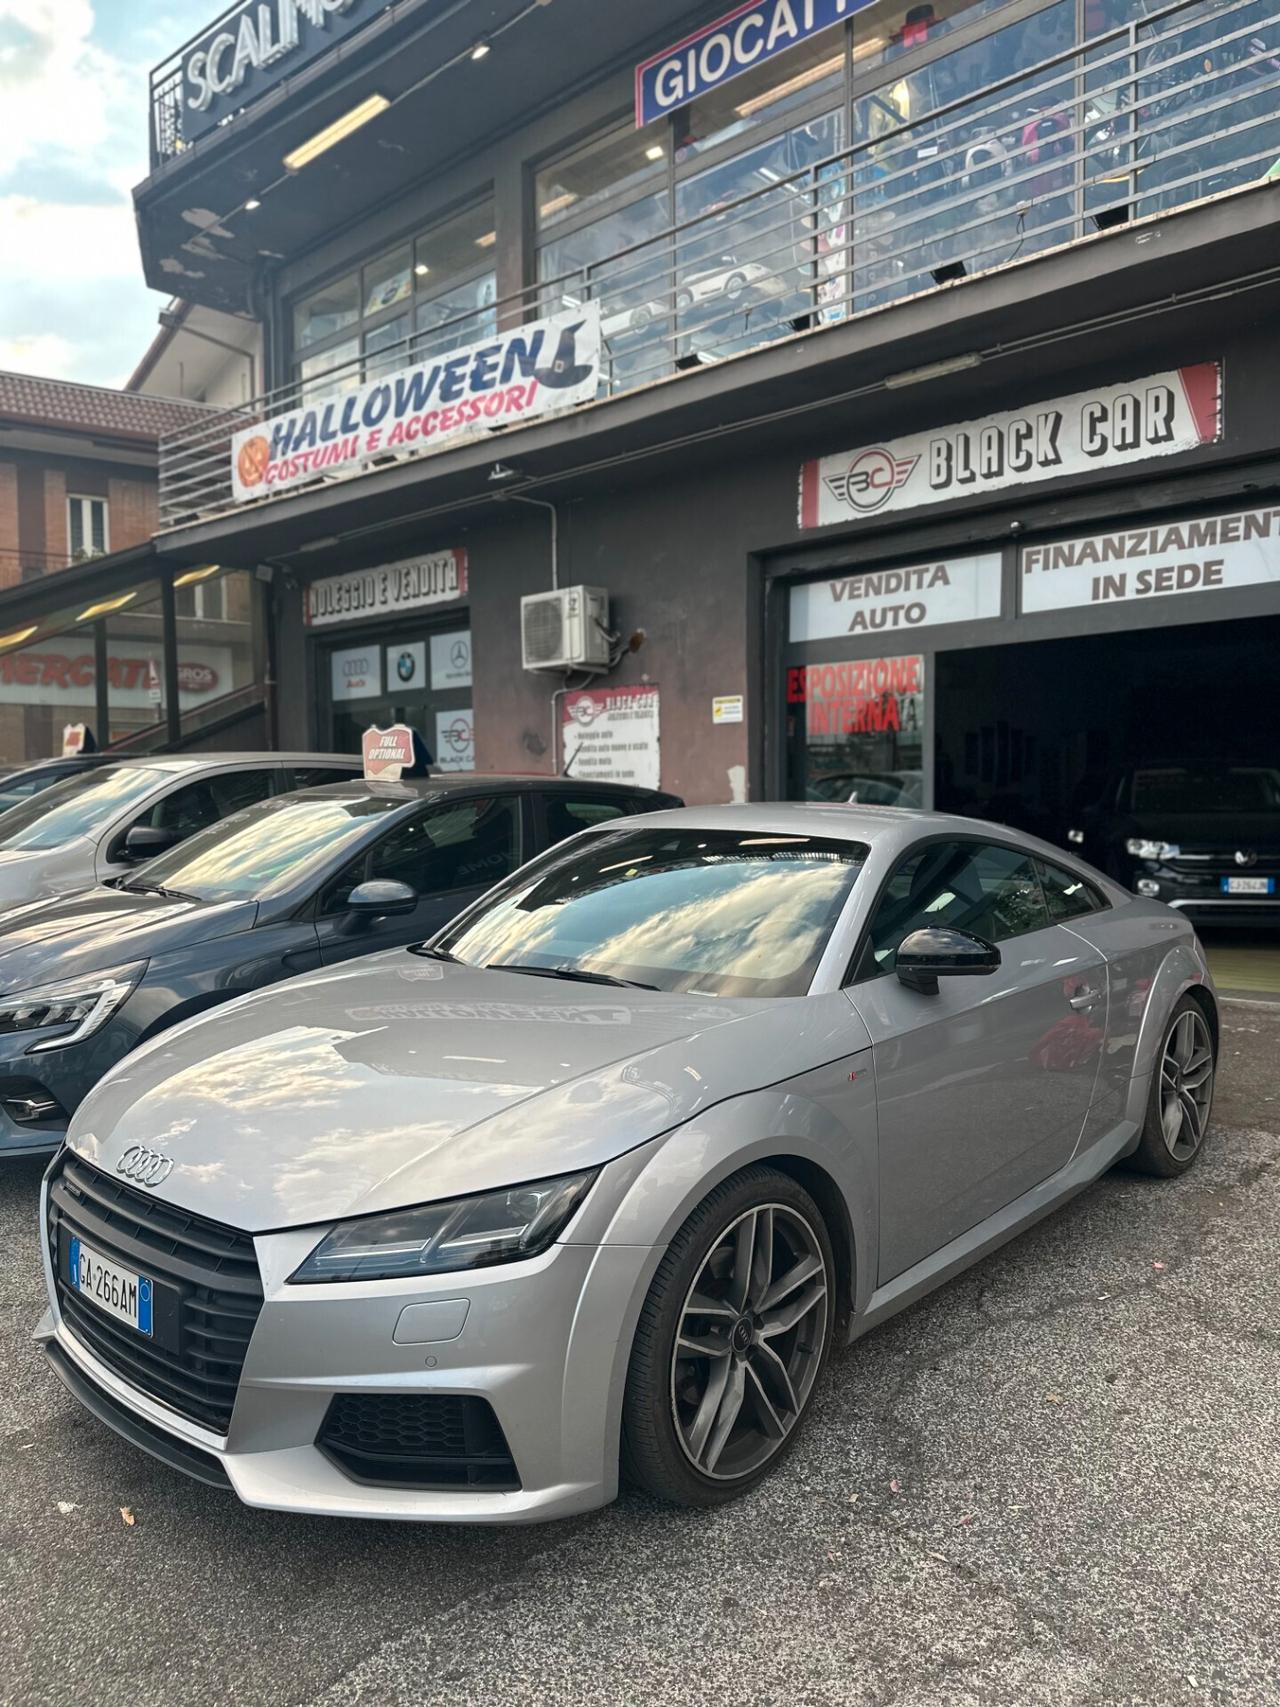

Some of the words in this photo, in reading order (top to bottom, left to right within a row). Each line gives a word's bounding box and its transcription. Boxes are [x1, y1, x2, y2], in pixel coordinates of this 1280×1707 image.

[654, 0, 846, 107] GIOCA
[269, 330, 545, 461] HALLOWEEN
[265, 435, 359, 484] COSTUMI
[365, 428, 382, 452] E
[387, 378, 539, 447] ACCESSORI
[930, 411, 1063, 490] BLACK
[1081, 385, 1175, 457] CAR
[309, 576, 375, 618] NOLEGGIO
[378, 572, 388, 605] E
[390, 557, 459, 602] VENDITA
[829, 564, 951, 602] VENDITA
[1092, 573, 1127, 601] IN
[1135, 559, 1224, 595] SEDE
[848, 602, 927, 632] AUTO
[787, 656, 921, 703] ESPOSIZIONE
[808, 692, 901, 737] INTERNA
[368, 748, 405, 760] OPTIONAL
[380, 736, 399, 747] FULL
